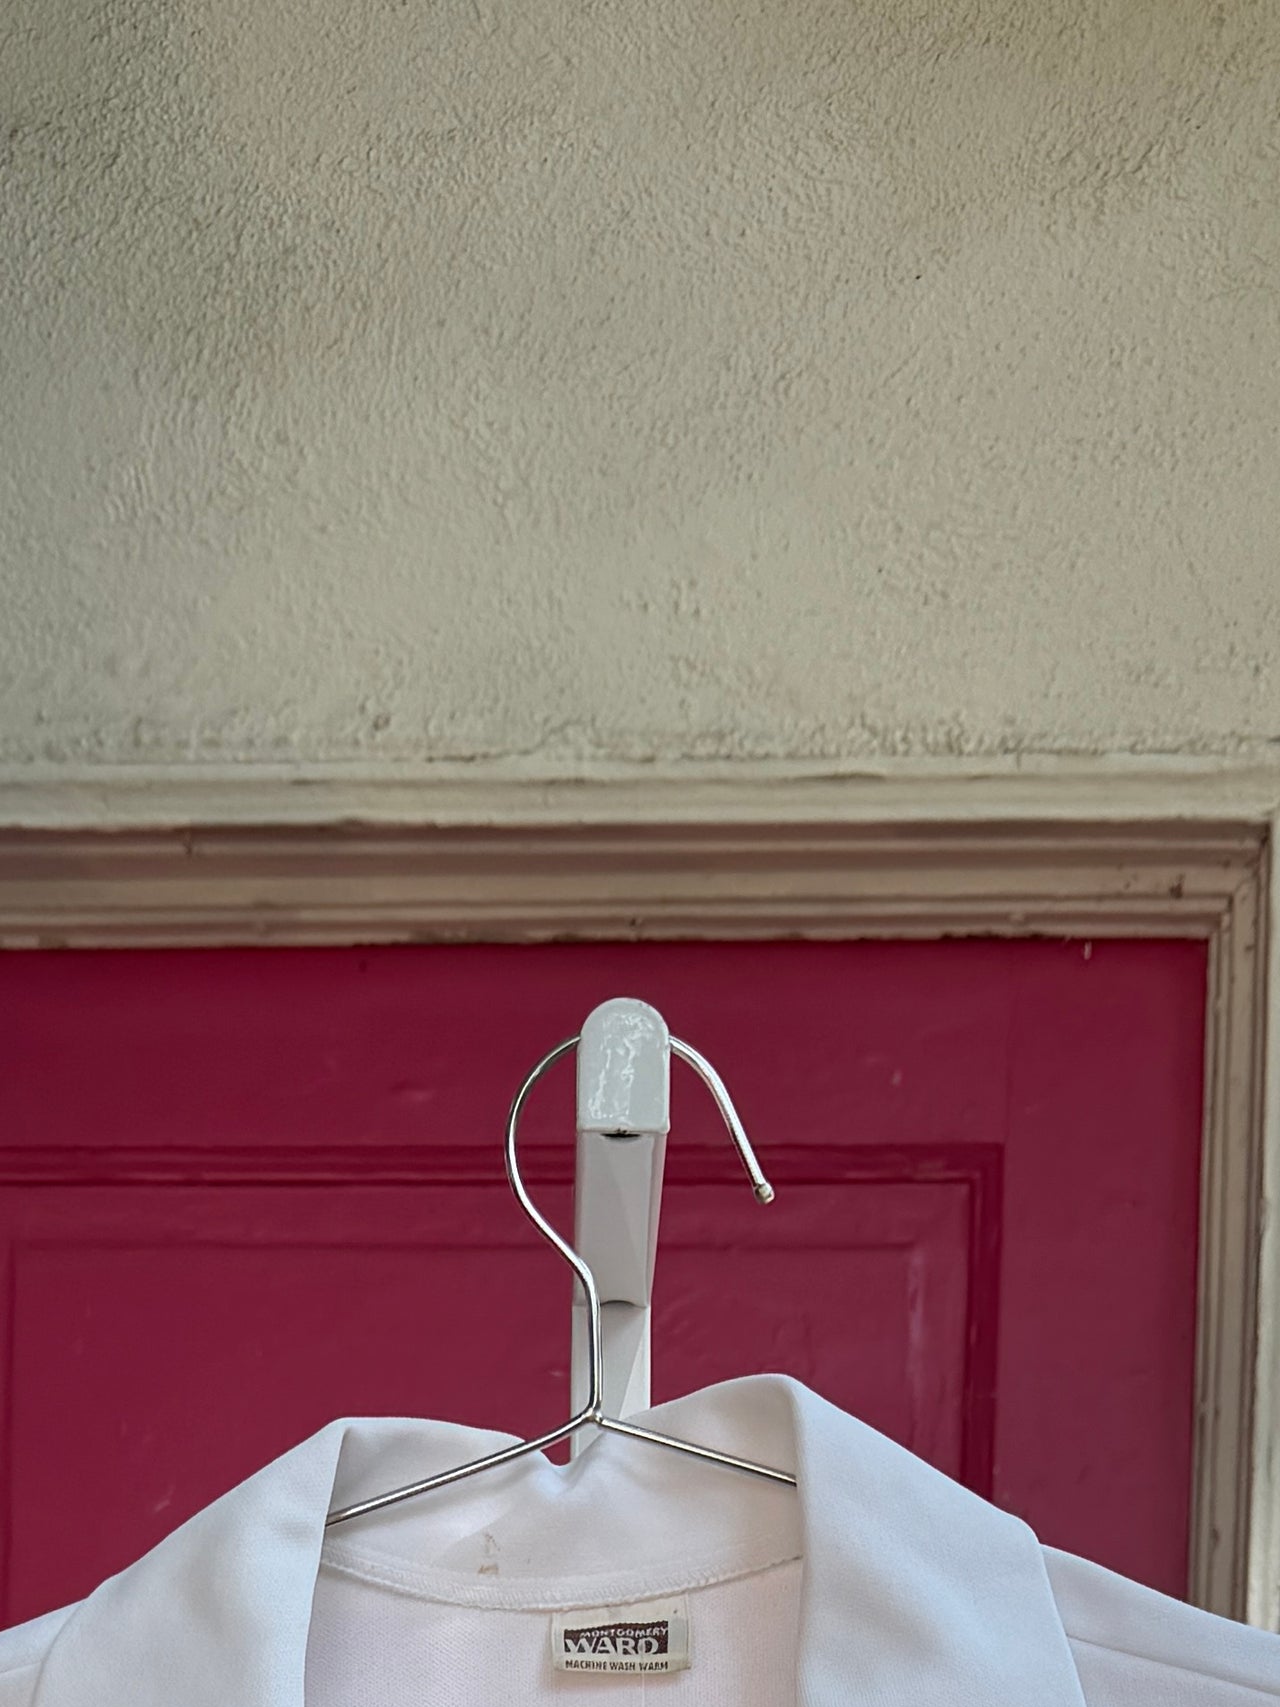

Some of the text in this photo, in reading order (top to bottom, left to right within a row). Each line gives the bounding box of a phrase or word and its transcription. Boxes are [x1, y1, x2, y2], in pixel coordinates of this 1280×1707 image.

[581, 1627, 668, 1638] MONTGOMERY
[565, 1637, 659, 1655] WARD
[565, 1660, 669, 1670] MACHINE WASH WARM
